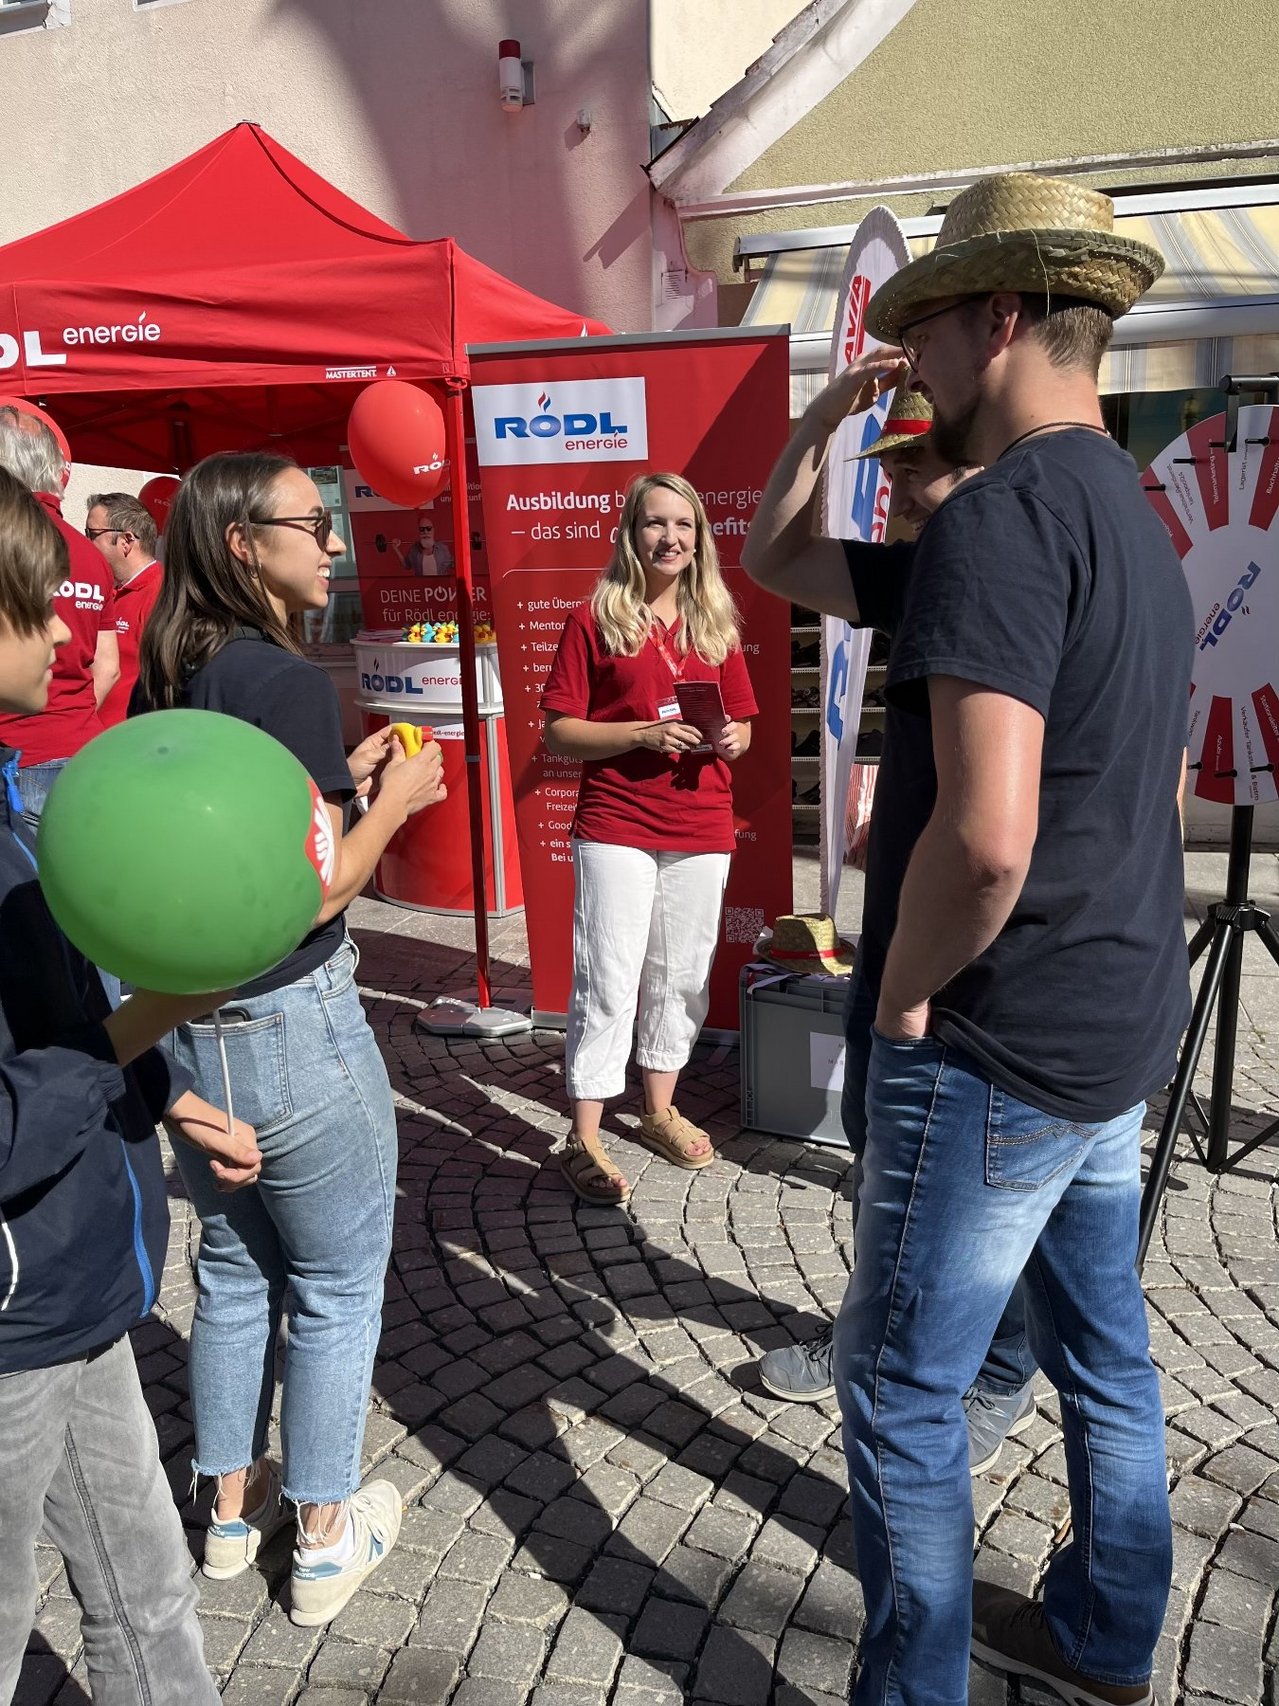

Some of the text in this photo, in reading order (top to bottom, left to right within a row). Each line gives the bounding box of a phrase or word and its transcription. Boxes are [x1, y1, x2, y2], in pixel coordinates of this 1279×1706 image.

[845, 275, 863, 365] AVIA
[63, 311, 161, 345] energie
[327, 369, 376, 379] MASTERTENT
[565, 433, 628, 450] energie
[1239, 461, 1248, 491] Lagerist
[506, 491, 611, 513] Ausbildung
[531, 522, 561, 540] das
[565, 520, 600, 540] sind
[712, 516, 751, 536] efit
[380, 590, 423, 604] DEINE
[527, 600, 550, 612] gute
[552, 597, 582, 609] Übern
[383, 608, 401, 622] für
[405, 608, 436, 622] Rödl
[530, 621, 565, 630] Mentor
[1194, 603, 1220, 645] energie
[531, 641, 559, 652] Teilze
[556, 770, 582, 778] unser
[545, 787, 579, 798] Corpora
[548, 820, 572, 830] Good
[734, 829, 757, 841] fung
[550, 838, 565, 848] ein
[551, 853, 566, 862] Bei
